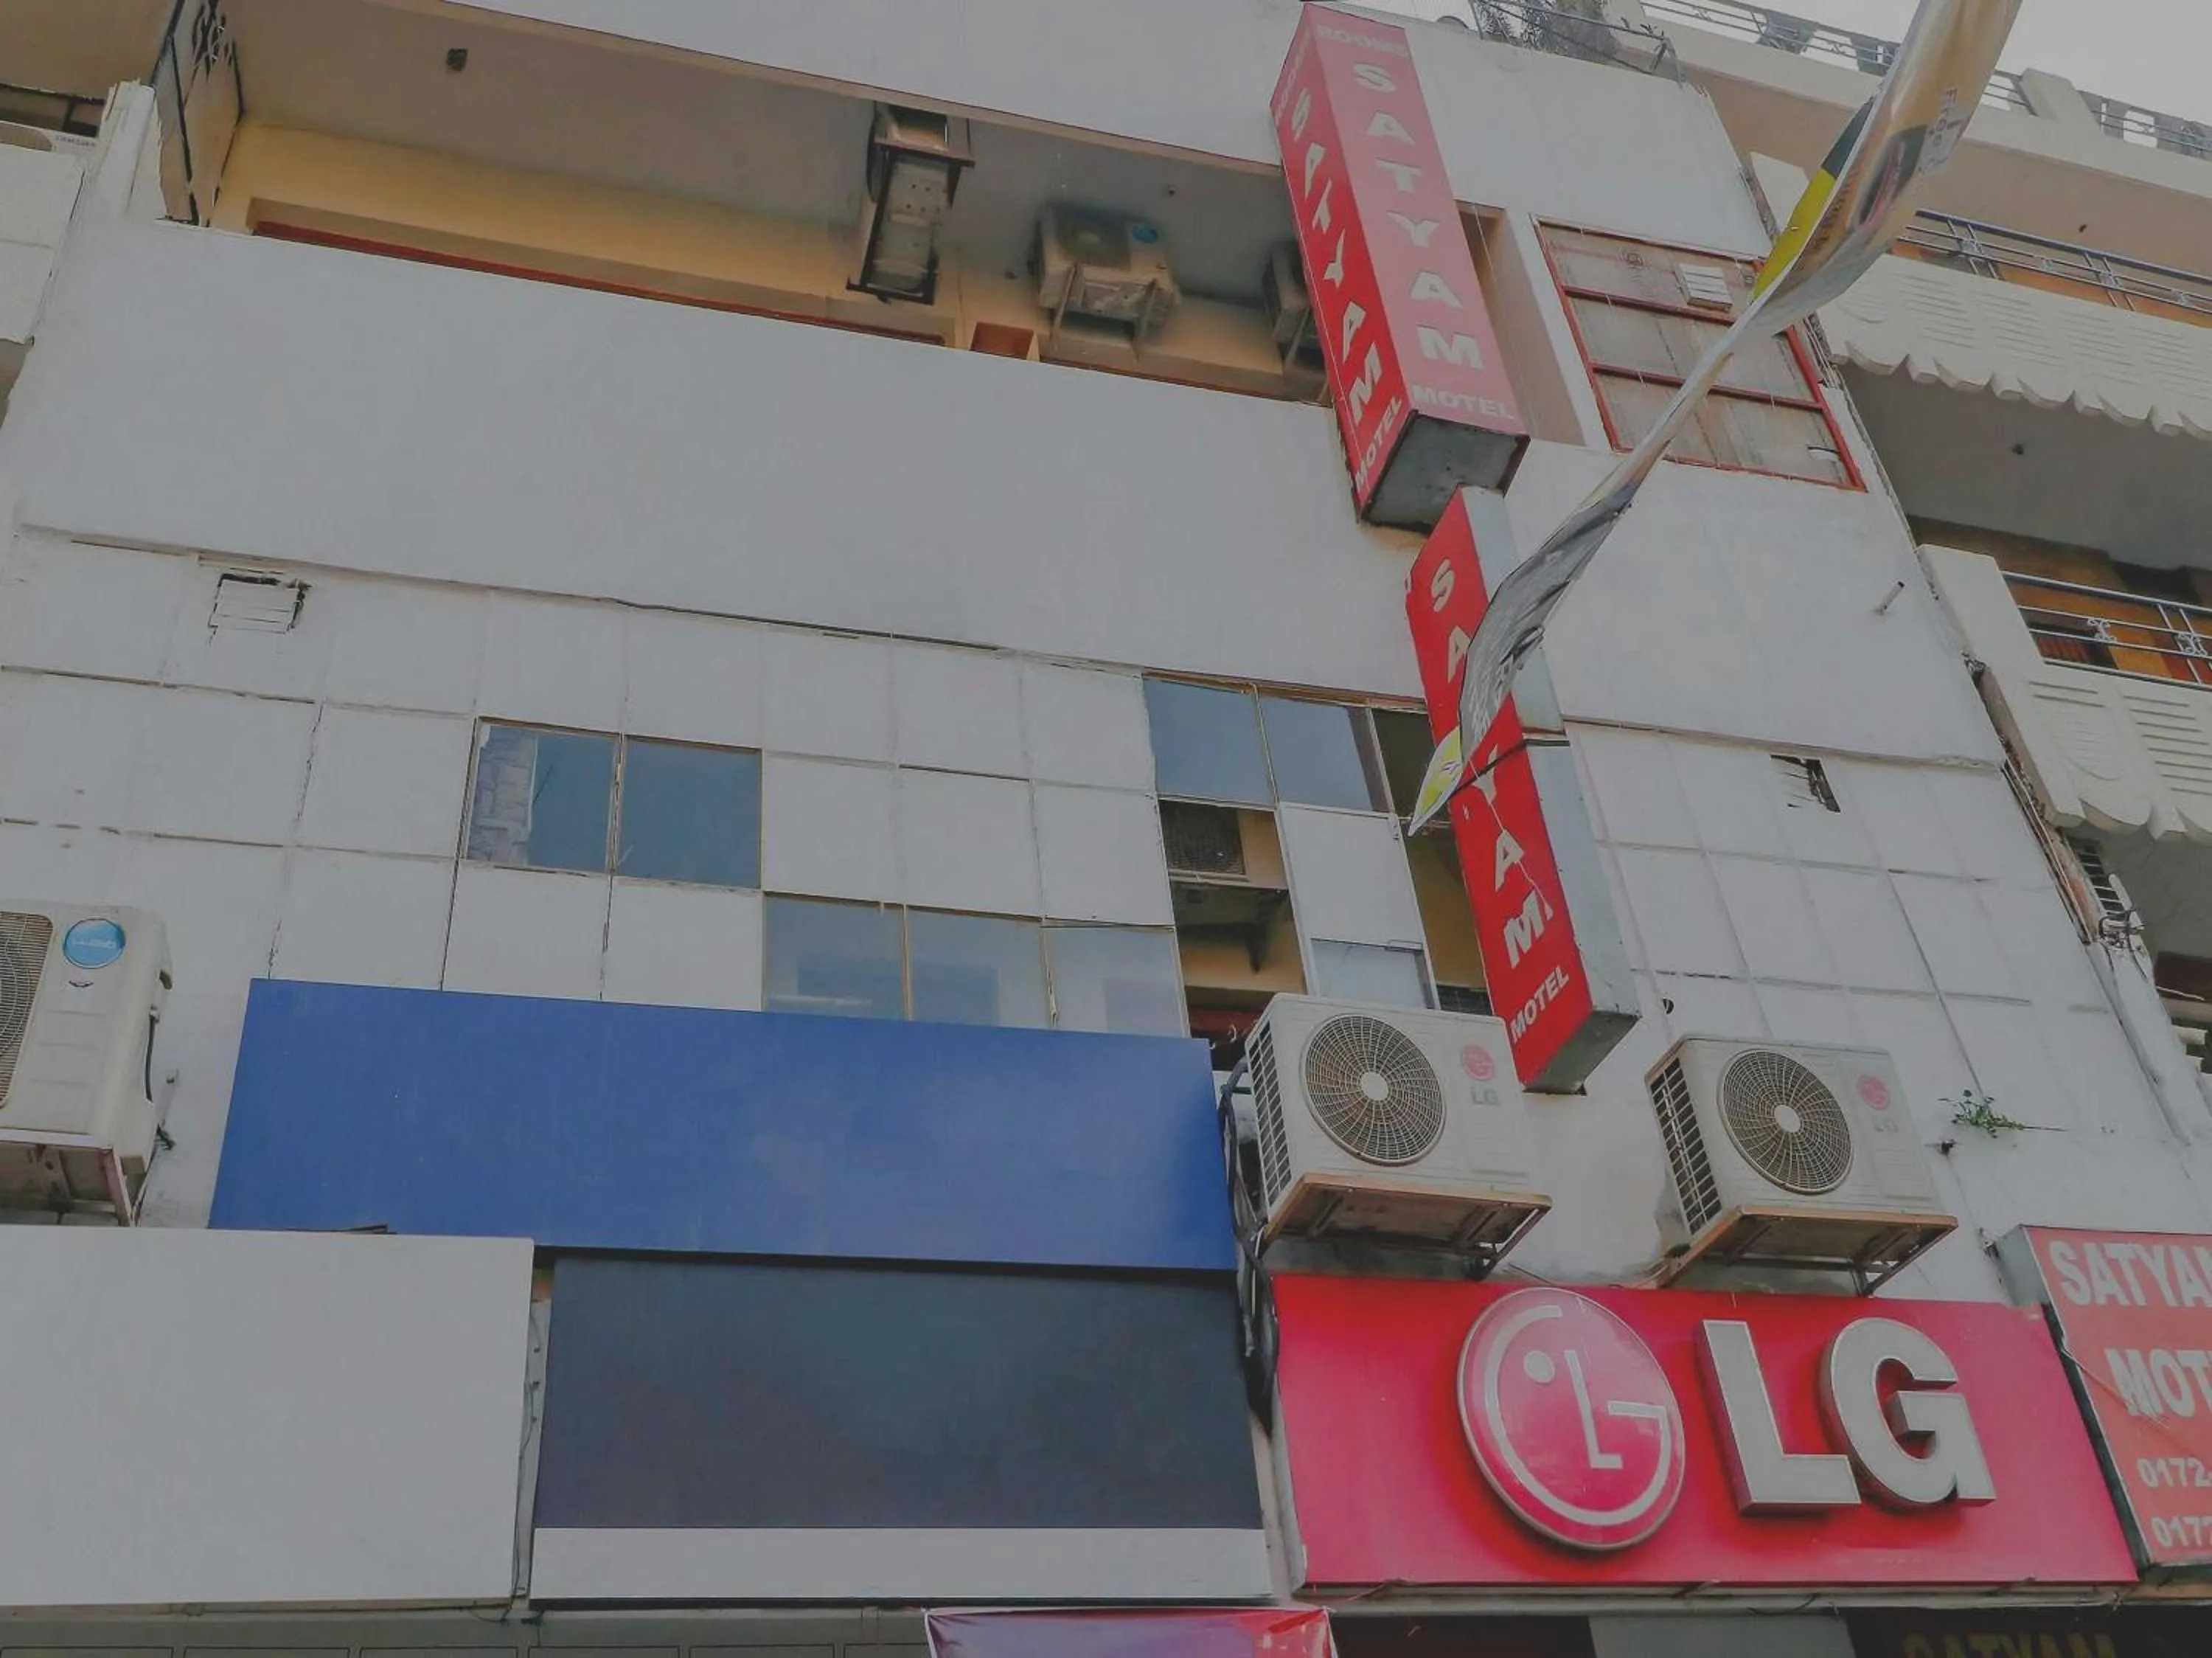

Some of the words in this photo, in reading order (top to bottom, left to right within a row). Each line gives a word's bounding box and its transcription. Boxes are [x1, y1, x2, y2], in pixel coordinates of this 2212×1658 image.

[1291, 87, 1382, 425] SATYAM
[1352, 62, 1484, 370] SATYAM
[1354, 398, 1402, 492] MOTEL
[1411, 384, 1514, 420] MOTEL
[1430, 558, 1553, 969] SAYAM
[1509, 965, 1570, 1045] MOTEL
[1697, 1317, 1997, 1516] LG
[2104, 1347, 2212, 1418] MOT
